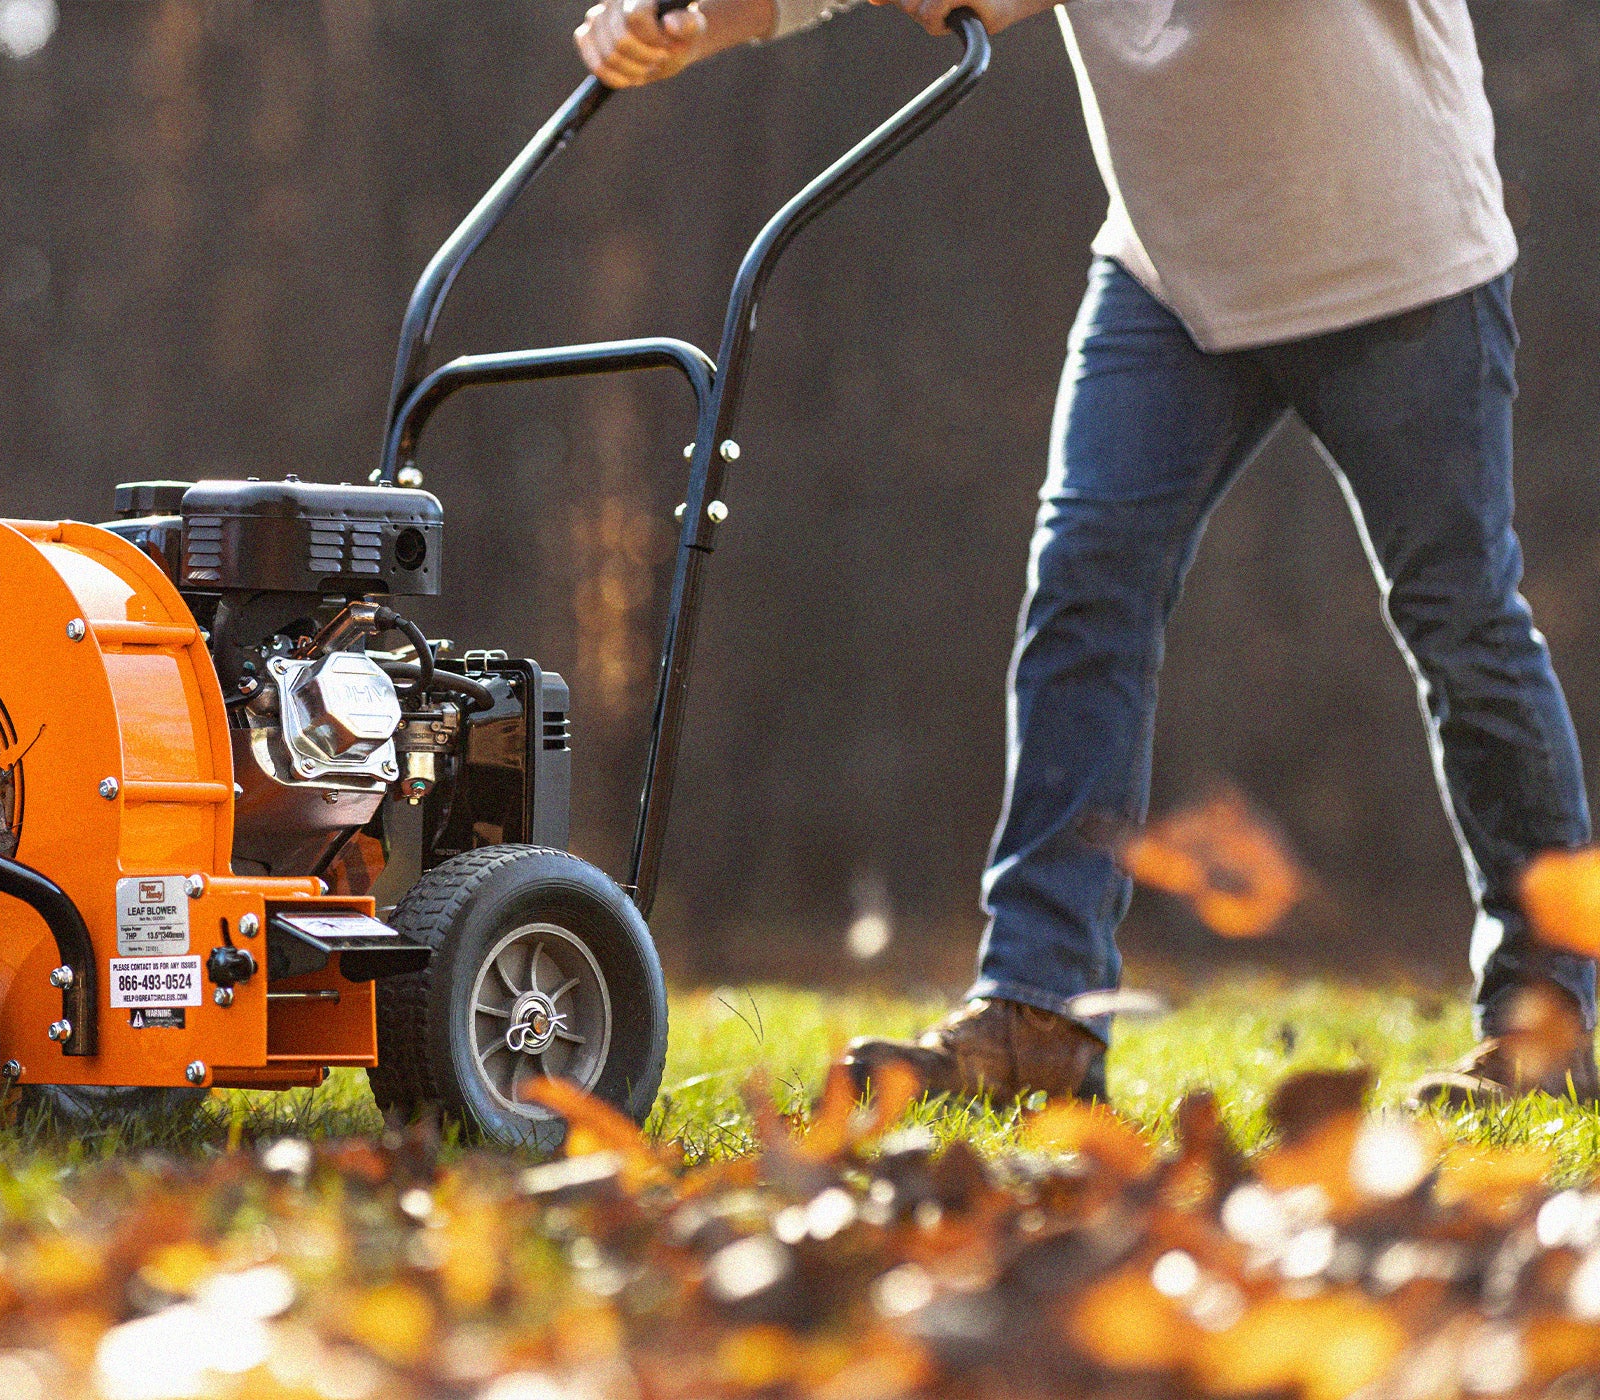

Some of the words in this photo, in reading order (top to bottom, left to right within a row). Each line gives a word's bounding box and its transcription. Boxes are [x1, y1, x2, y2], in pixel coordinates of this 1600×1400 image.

[127, 907, 145, 916] LEAF
[146, 905, 177, 915] BLOWER
[125, 932, 137, 940] 7HP
[113, 963, 129, 971] PLEASE
[131, 962, 151, 971] CONTACT
[153, 962, 159, 970] US
[160, 962, 169, 970] FOR
[170, 961, 179, 969] ANY
[181, 961, 196, 969] ISSUES
[118, 973, 192, 991] 866-493-0524
[145, 1009, 172, 1017] WARNING
